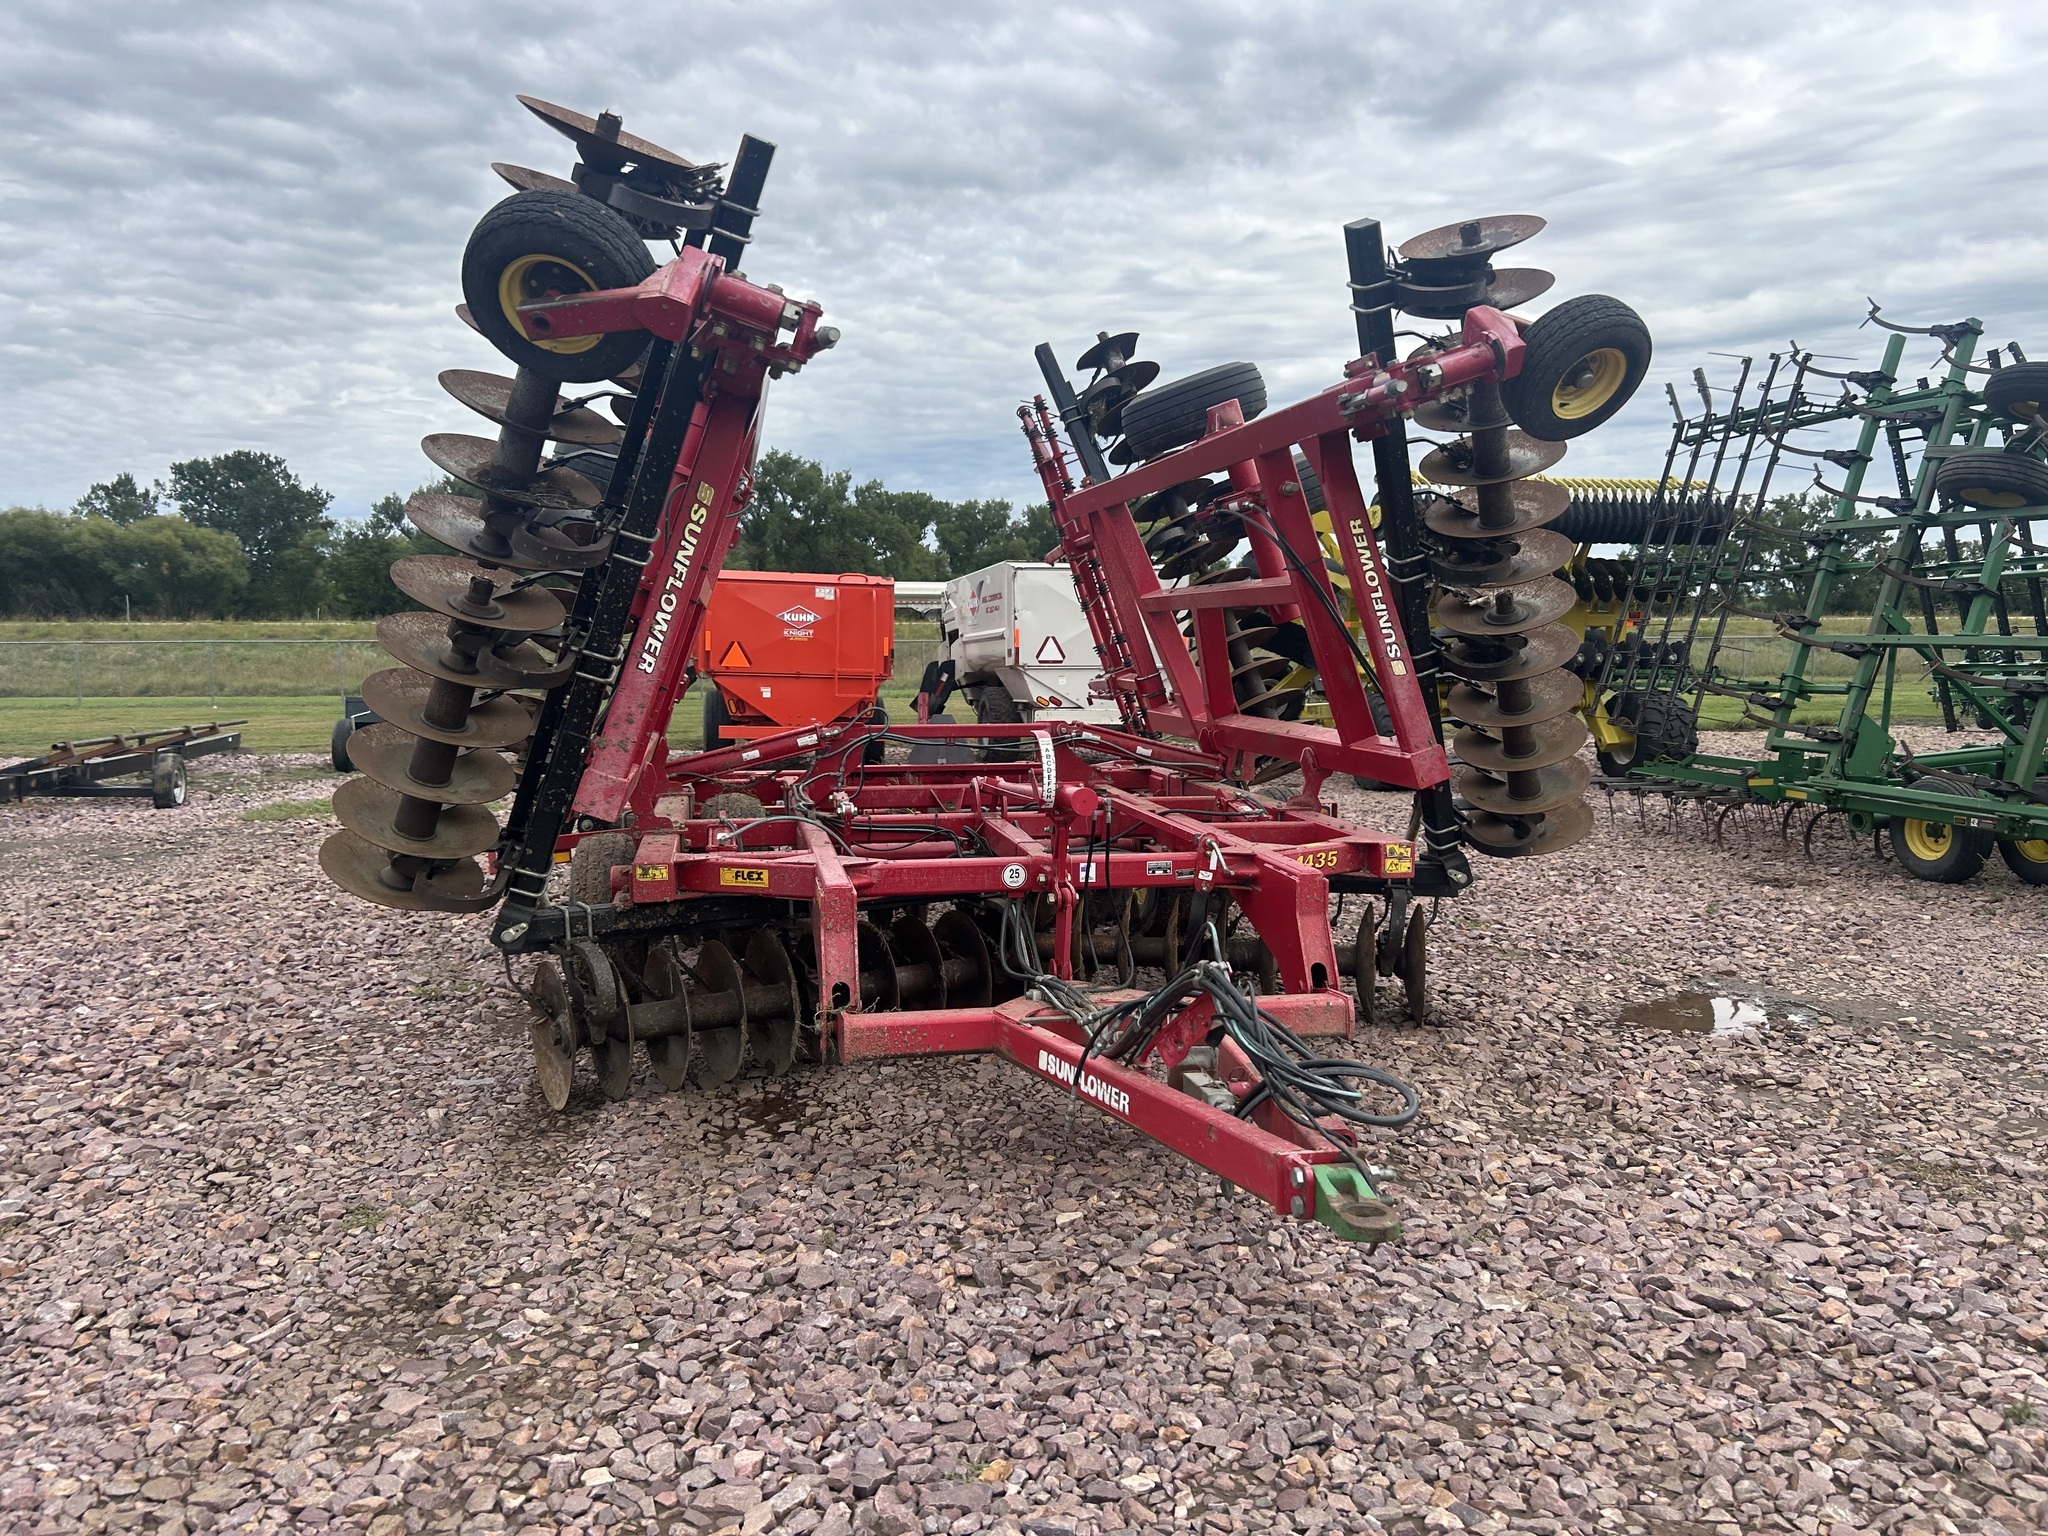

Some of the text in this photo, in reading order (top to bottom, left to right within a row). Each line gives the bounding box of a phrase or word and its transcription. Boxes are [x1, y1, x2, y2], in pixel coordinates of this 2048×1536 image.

[637, 502, 708, 675] SUNFLOWER
[783, 613, 815, 622] KUHN
[1349, 518, 1402, 658] SUNFLOWER
[1008, 868, 1020, 879] 25
[1047, 1053, 1130, 1116] SUNLOWER
